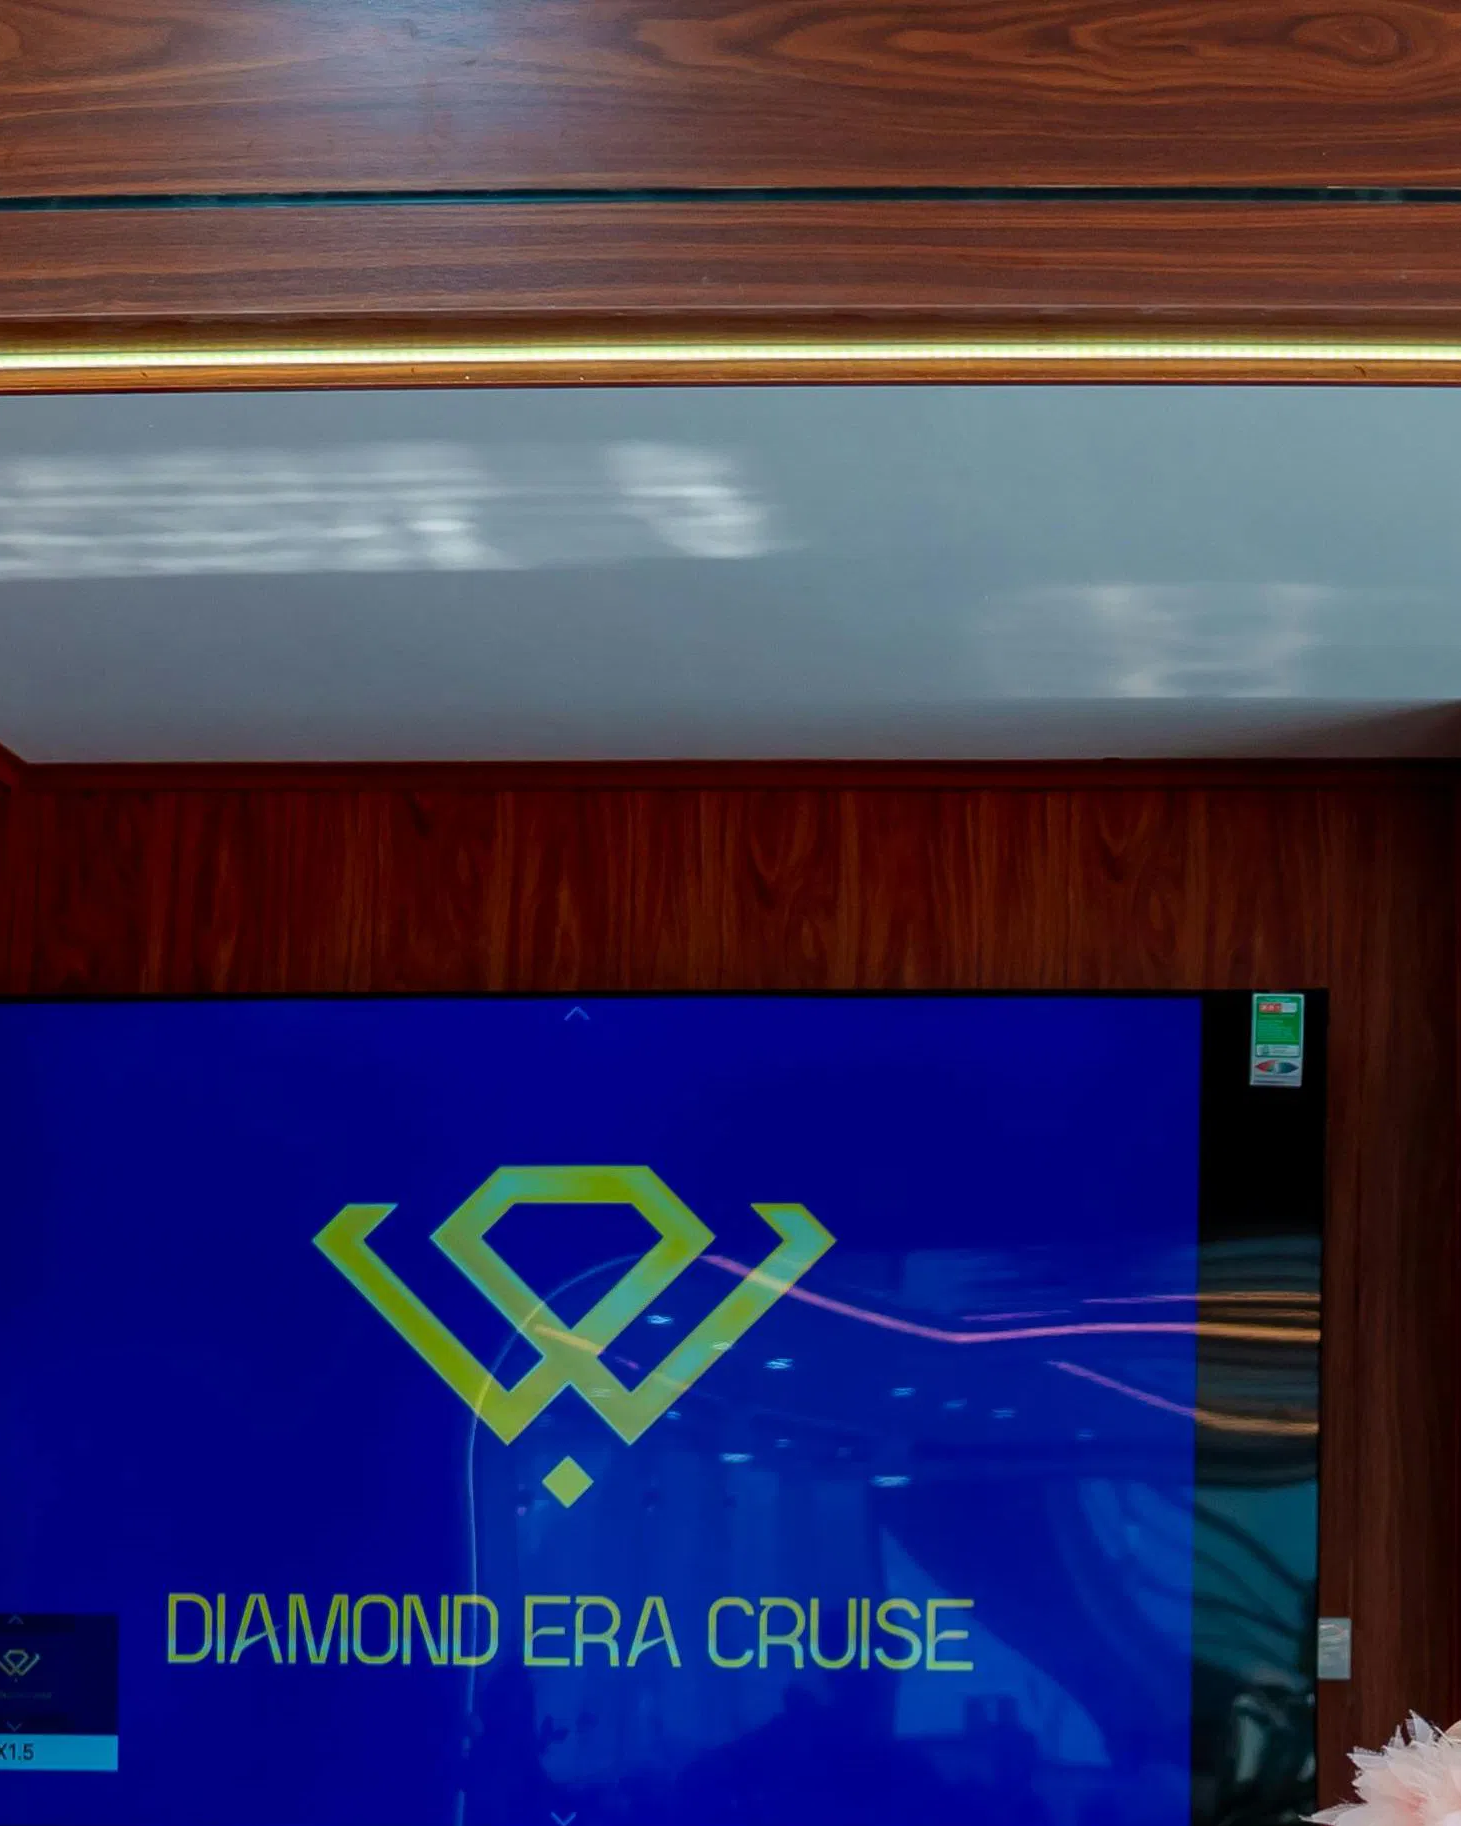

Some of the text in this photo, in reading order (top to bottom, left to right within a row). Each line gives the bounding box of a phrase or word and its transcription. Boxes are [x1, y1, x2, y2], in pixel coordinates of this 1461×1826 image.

[167, 1592, 976, 1672] DIAMOND ERA CRUISE
